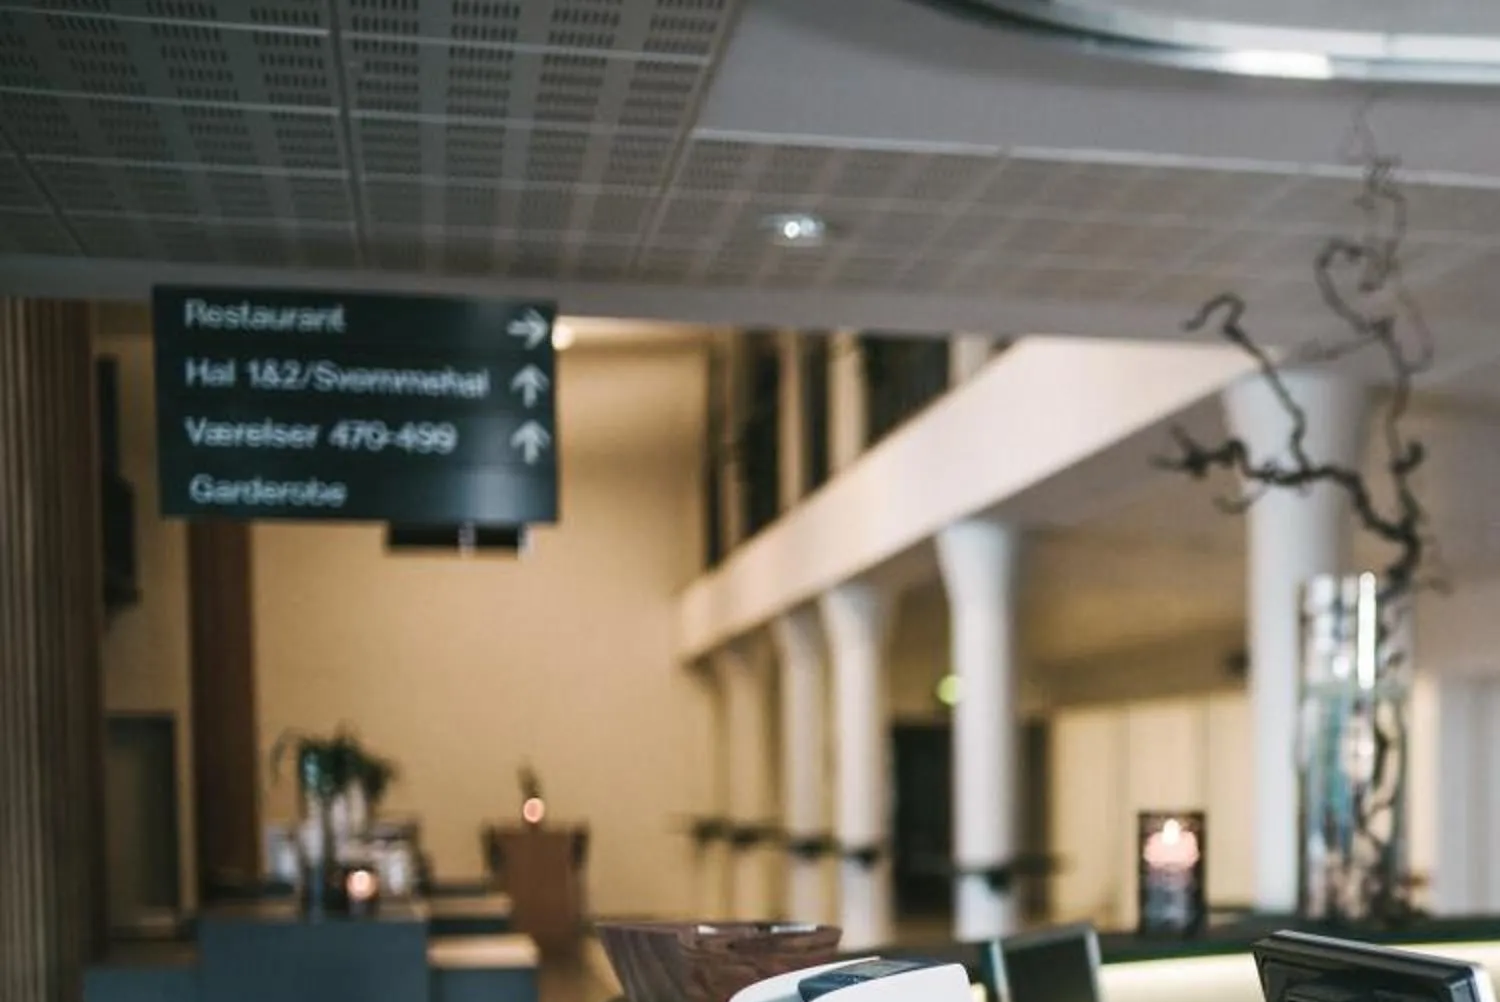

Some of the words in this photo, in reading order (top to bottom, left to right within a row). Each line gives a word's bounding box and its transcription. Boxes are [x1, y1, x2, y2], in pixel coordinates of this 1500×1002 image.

[184, 299, 344, 333] Restaurant
[185, 358, 235, 388] Hal
[184, 416, 321, 448] Værelser
[189, 473, 348, 509] Garderobe
